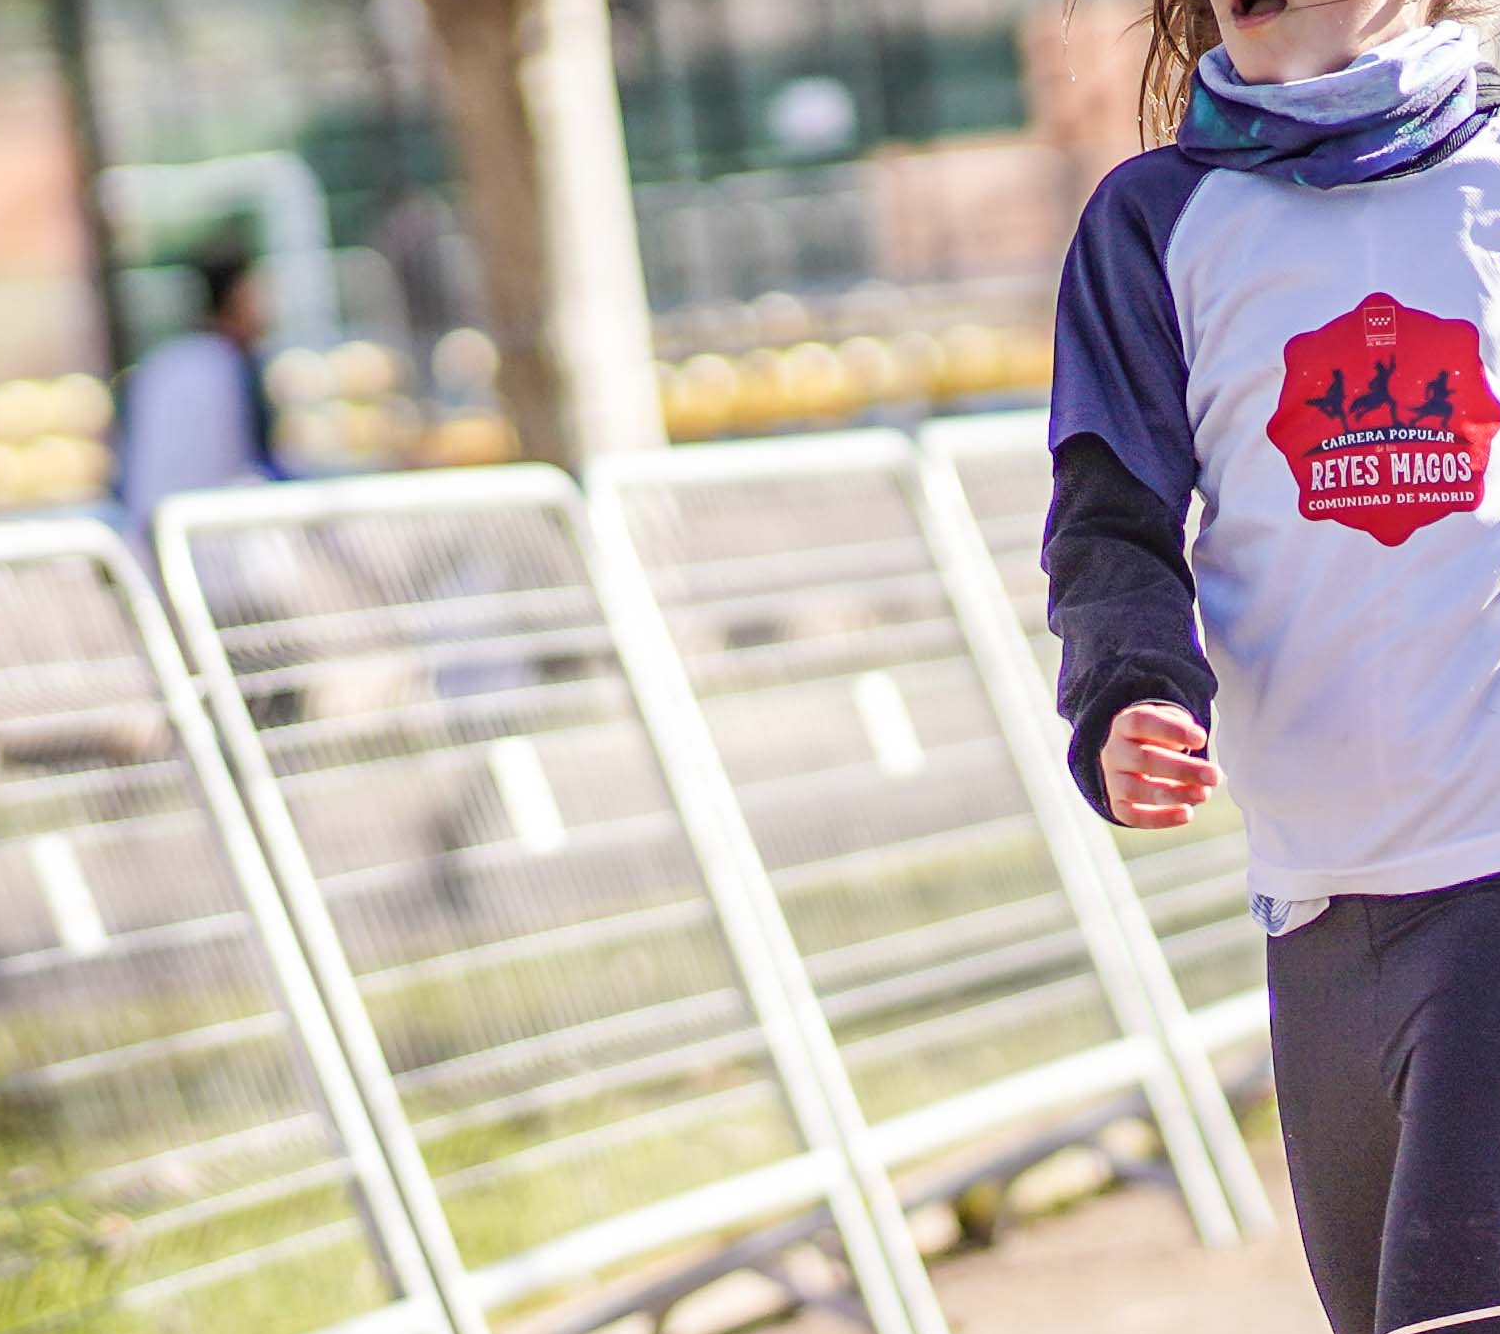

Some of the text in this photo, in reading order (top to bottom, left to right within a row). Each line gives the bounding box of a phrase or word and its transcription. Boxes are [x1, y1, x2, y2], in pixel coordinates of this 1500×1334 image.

[1321, 429, 1386, 450] CARRERA
[1389, 428, 1455, 444] POPULAR
[1311, 452, 1472, 491] REYES MAGOS
[1308, 491, 1475, 511] COMUNIDAD DE MADRID
